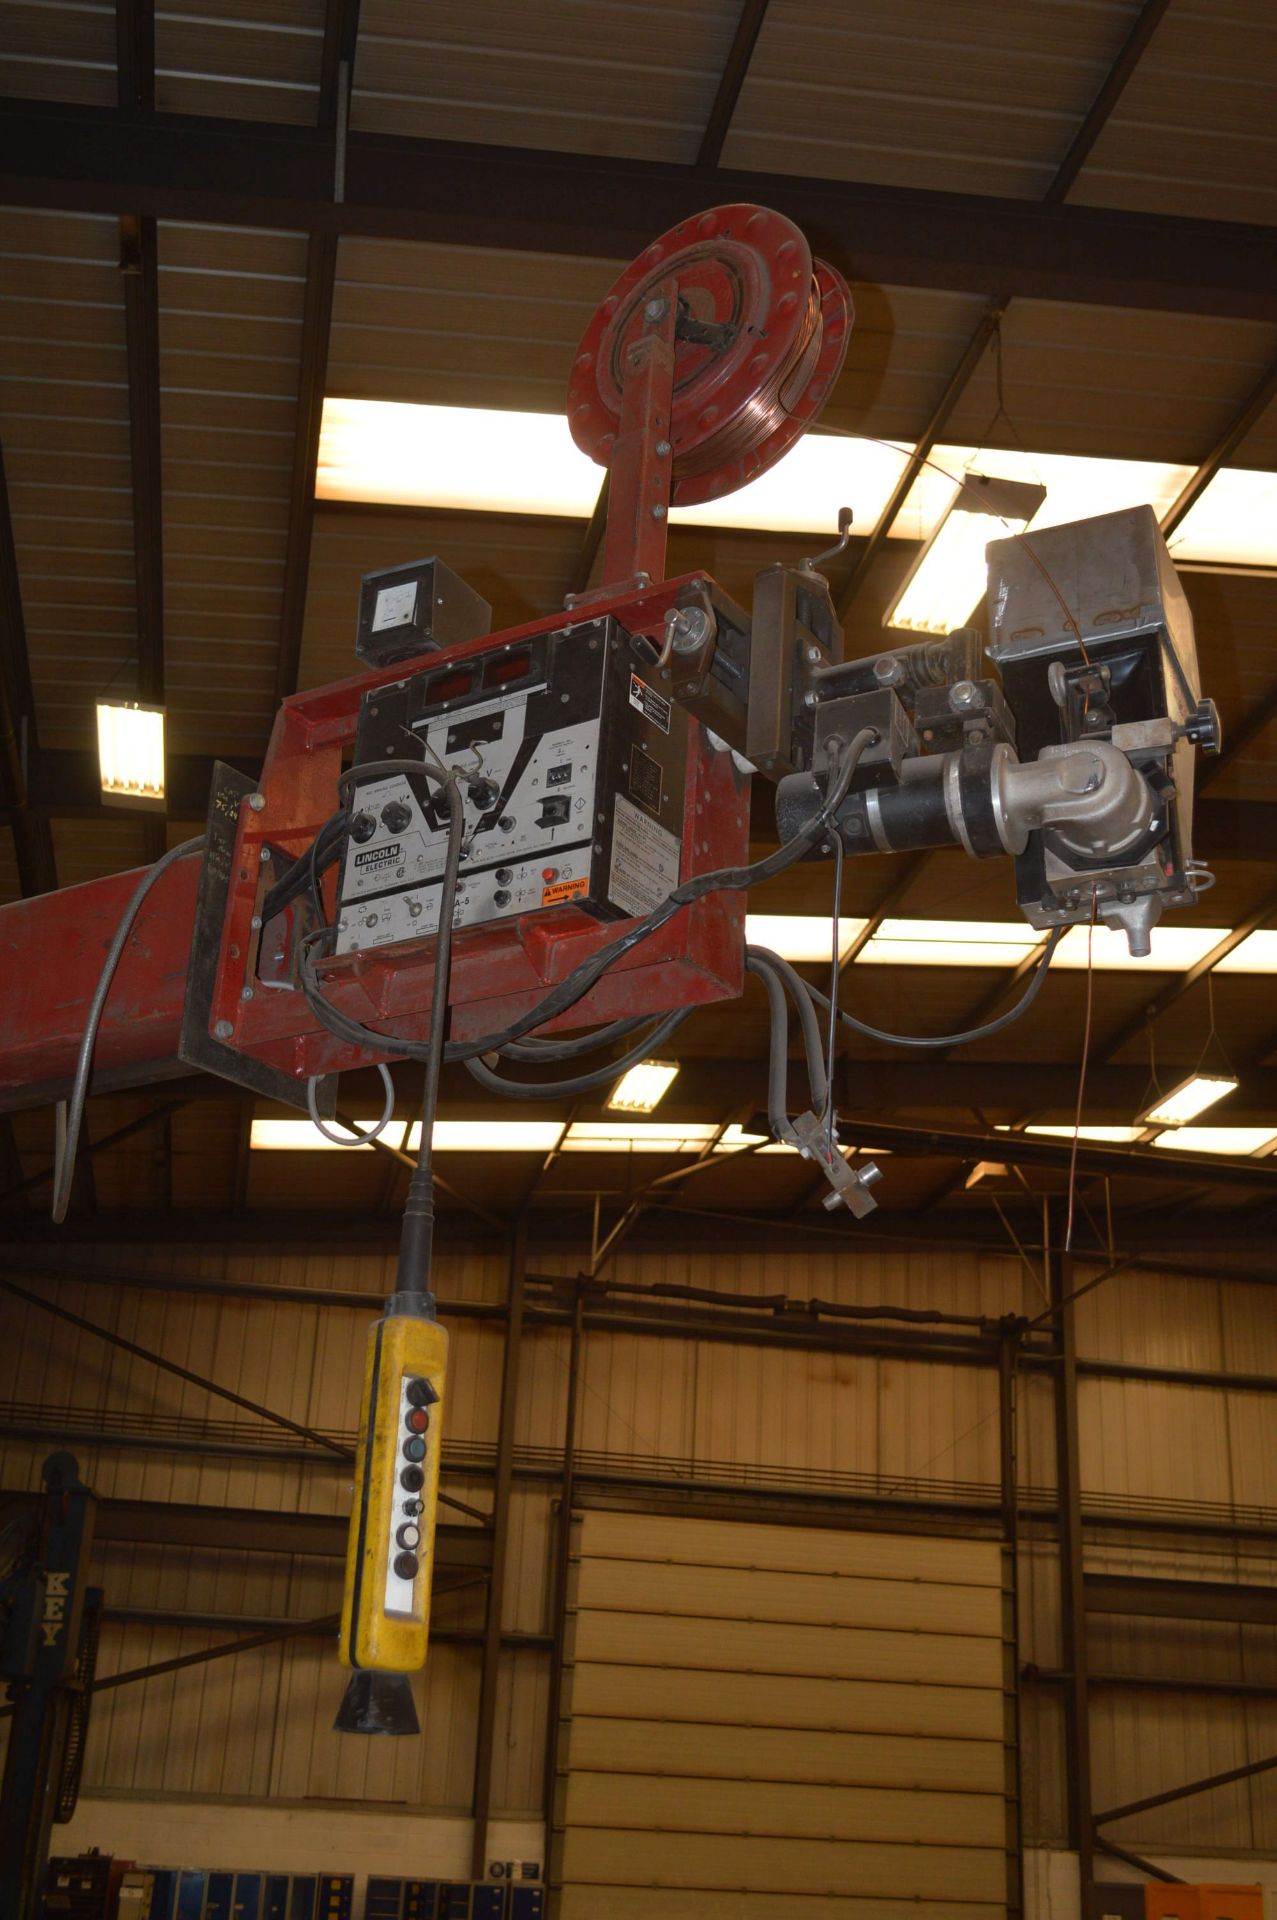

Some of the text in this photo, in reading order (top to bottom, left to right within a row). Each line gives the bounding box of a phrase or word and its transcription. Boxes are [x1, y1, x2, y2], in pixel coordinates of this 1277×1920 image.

[633, 809, 663, 838] WARNING
[355, 846, 400, 866] LINCOLN
[365, 857, 401, 873] ELECTRIC
[552, 880, 585, 895] WARNING
[41, 1571, 71, 1648] KEY
